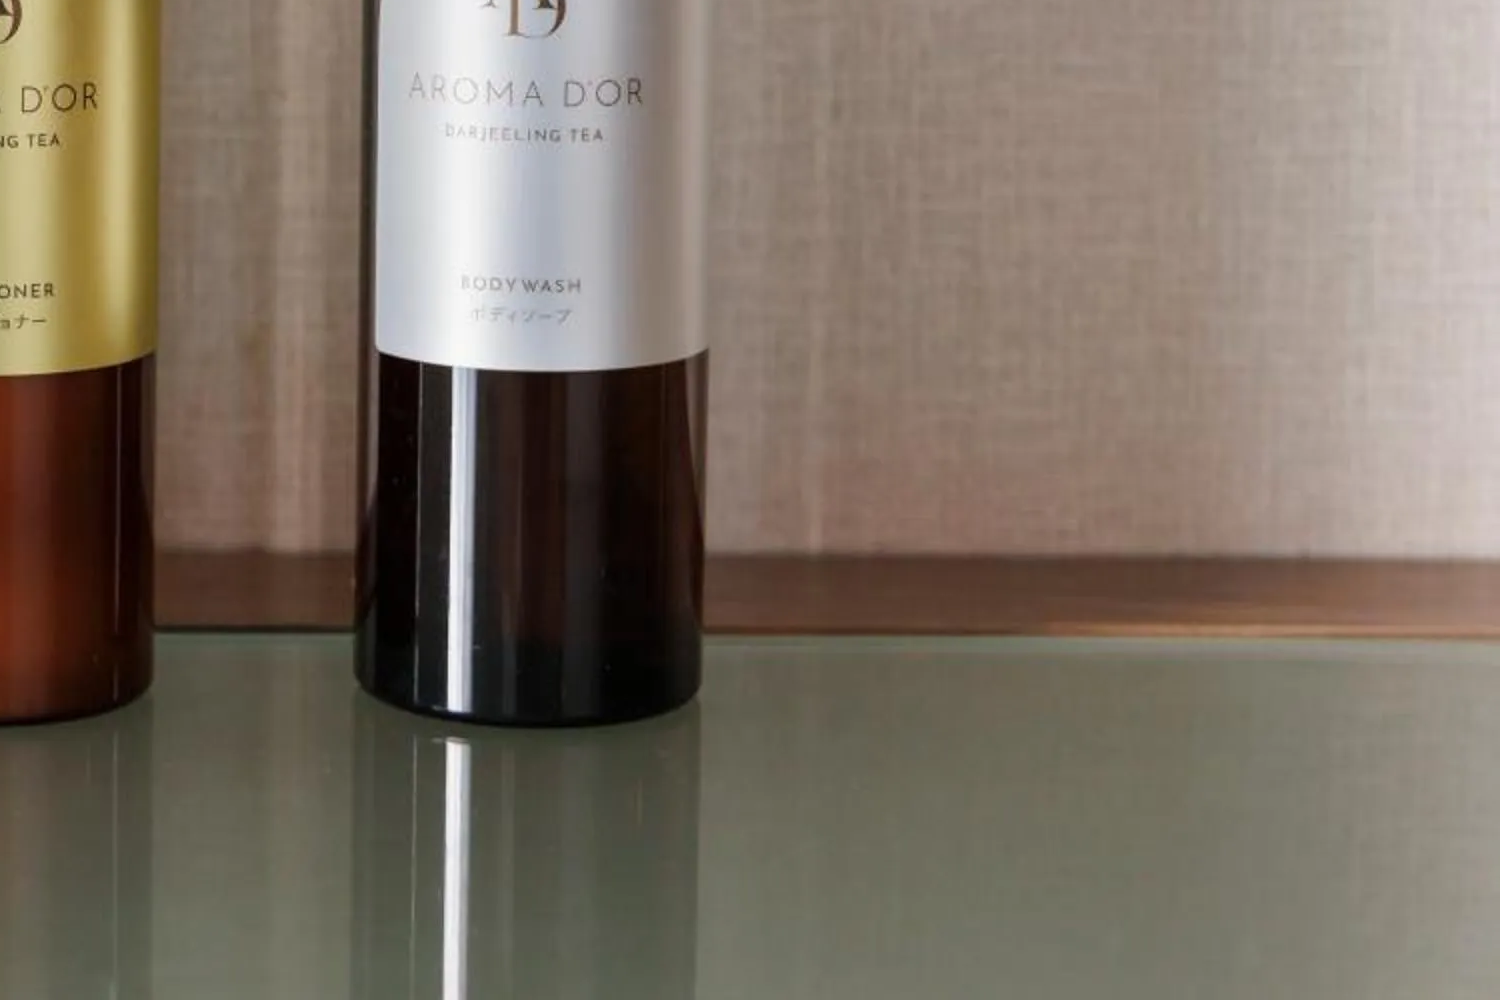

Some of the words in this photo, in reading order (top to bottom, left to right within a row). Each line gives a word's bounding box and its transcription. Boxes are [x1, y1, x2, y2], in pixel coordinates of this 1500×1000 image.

[21, 82, 98, 113] D'OR
[408, 71, 544, 108] AROMA
[563, 77, 643, 108] D'OR
[27, 133, 61, 148] TEA
[445, 122, 561, 143] DARJEELING
[570, 126, 604, 143] TEA
